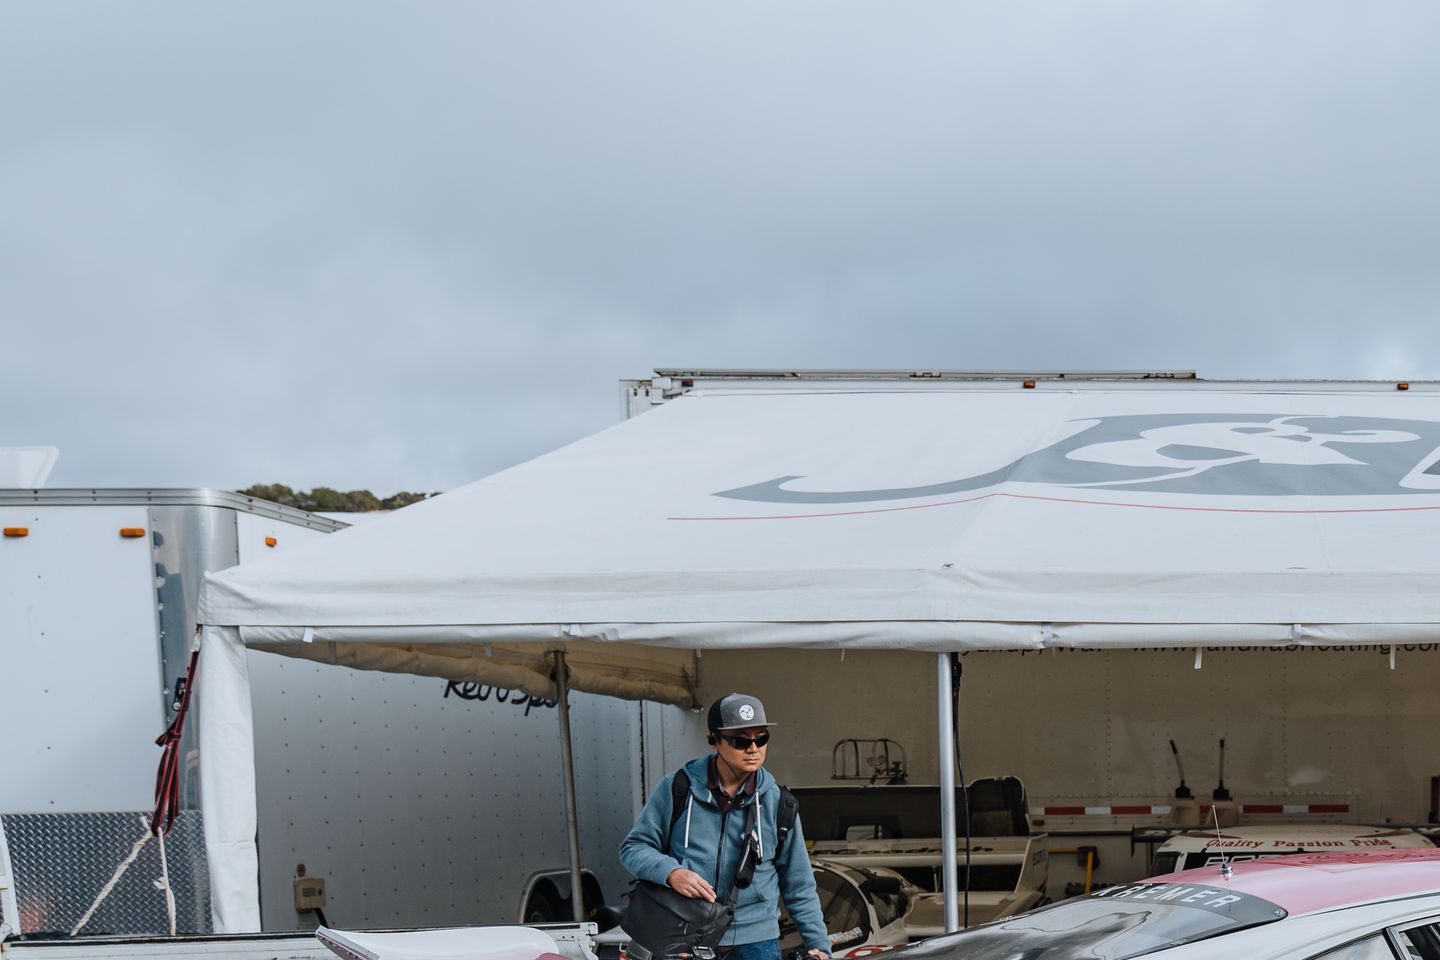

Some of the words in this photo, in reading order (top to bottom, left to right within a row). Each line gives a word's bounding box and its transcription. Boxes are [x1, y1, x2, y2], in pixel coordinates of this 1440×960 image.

[1206, 838, 1265, 850] Quality
[1274, 838, 1345, 848] Passion
[1349, 836, 1392, 847] Pride
